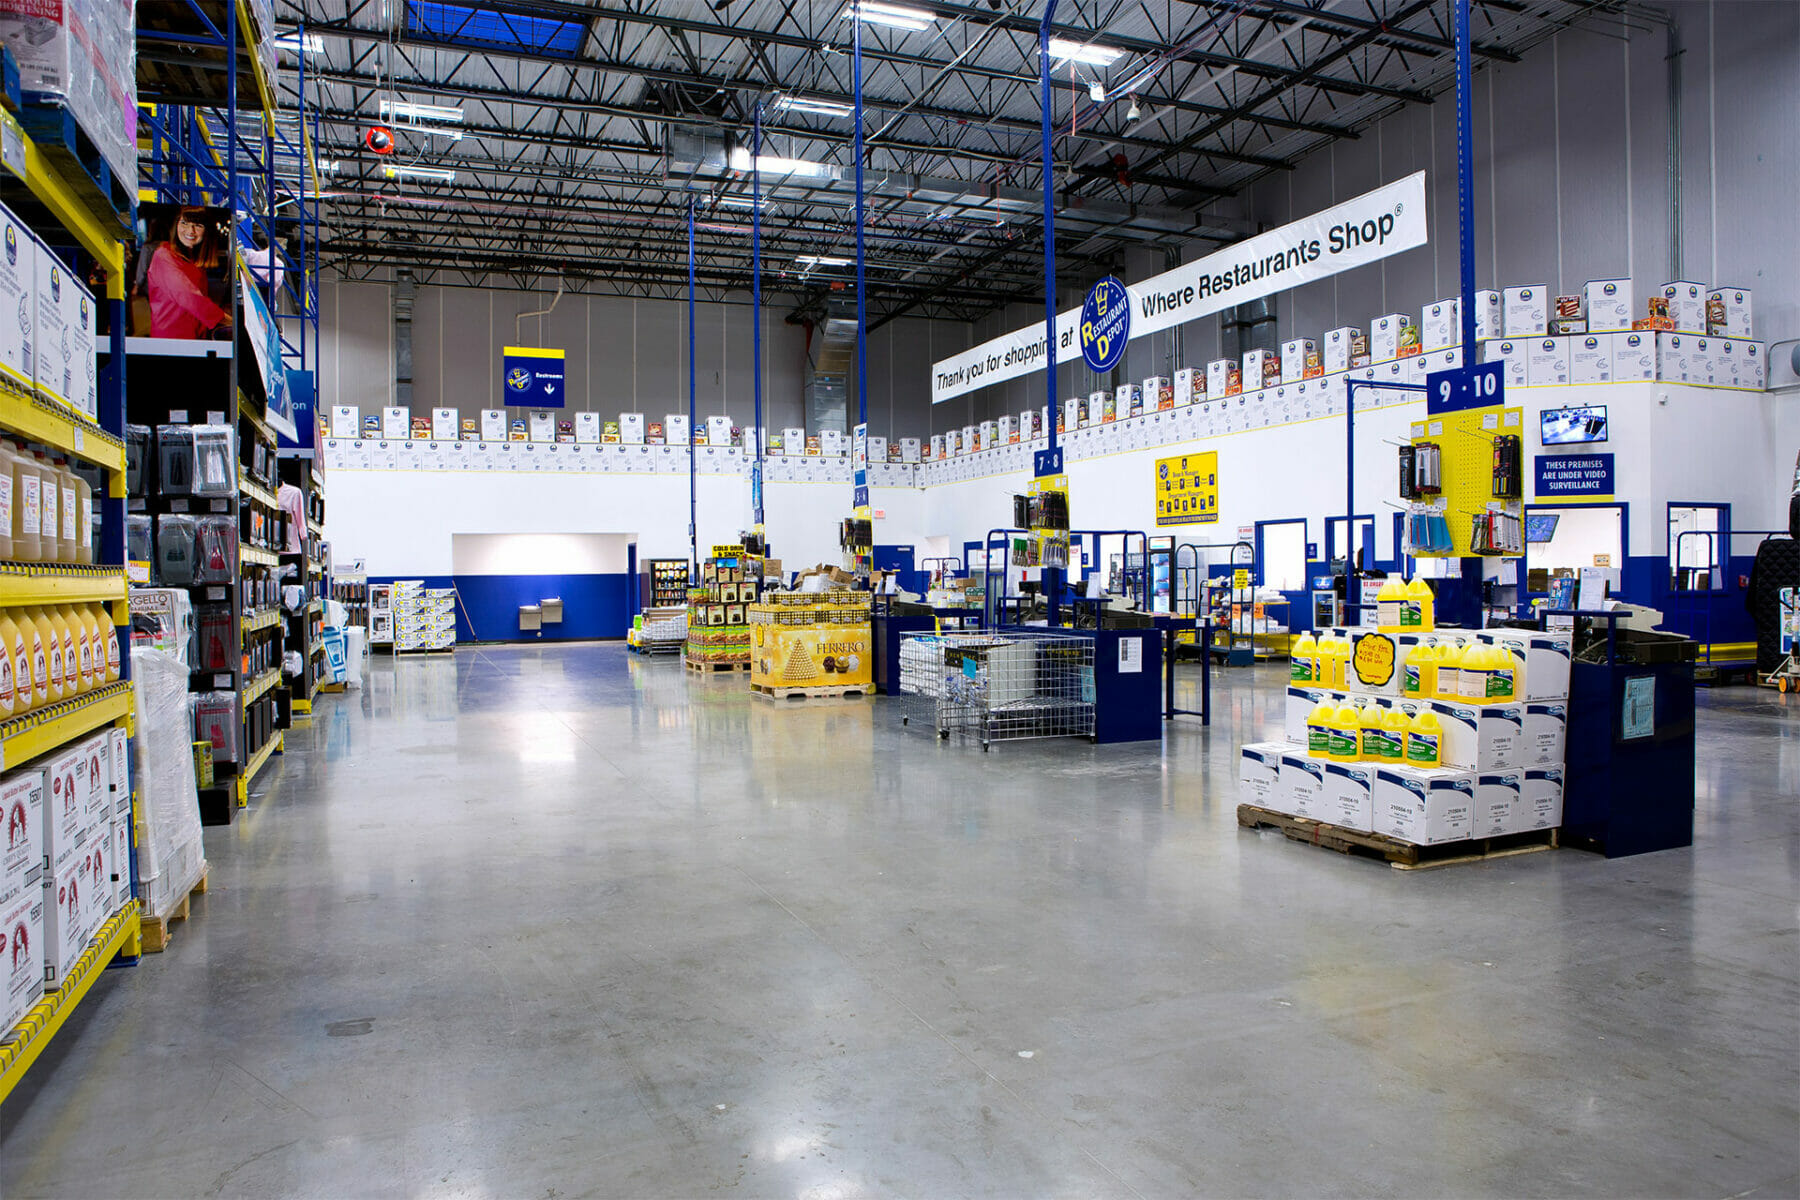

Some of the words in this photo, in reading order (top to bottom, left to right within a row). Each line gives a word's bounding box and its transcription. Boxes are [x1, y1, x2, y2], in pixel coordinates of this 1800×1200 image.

[1142, 285, 1194, 318] Where
[1199, 238, 1320, 299] Restaurants
[1081, 296, 1127, 347] RESTAURANT
[1097, 318, 1124, 360] DEPOT
[937, 366, 965, 390] Thank
[966, 363, 984, 385] you
[986, 353, 1001, 373] for
[1004, 336, 1057, 368] shoppin
[1061, 326, 1074, 348] at
[1439, 380, 1451, 403] 9
[1473, 373, 1496, 397] 10
[1039, 456, 1045, 471] 7
[1053, 454, 1059, 468] 8
[1545, 461, 1567, 469] THESE
[1568, 460, 1603, 469] PREMISES
[1542, 471, 1557, 479] ARE
[1558, 471, 1582, 479] UNDER
[1584, 470, 1607, 479] VIDEO
[1549, 481, 1600, 490] SURVEILLANCE
[816, 641, 865, 654] FERRERO
